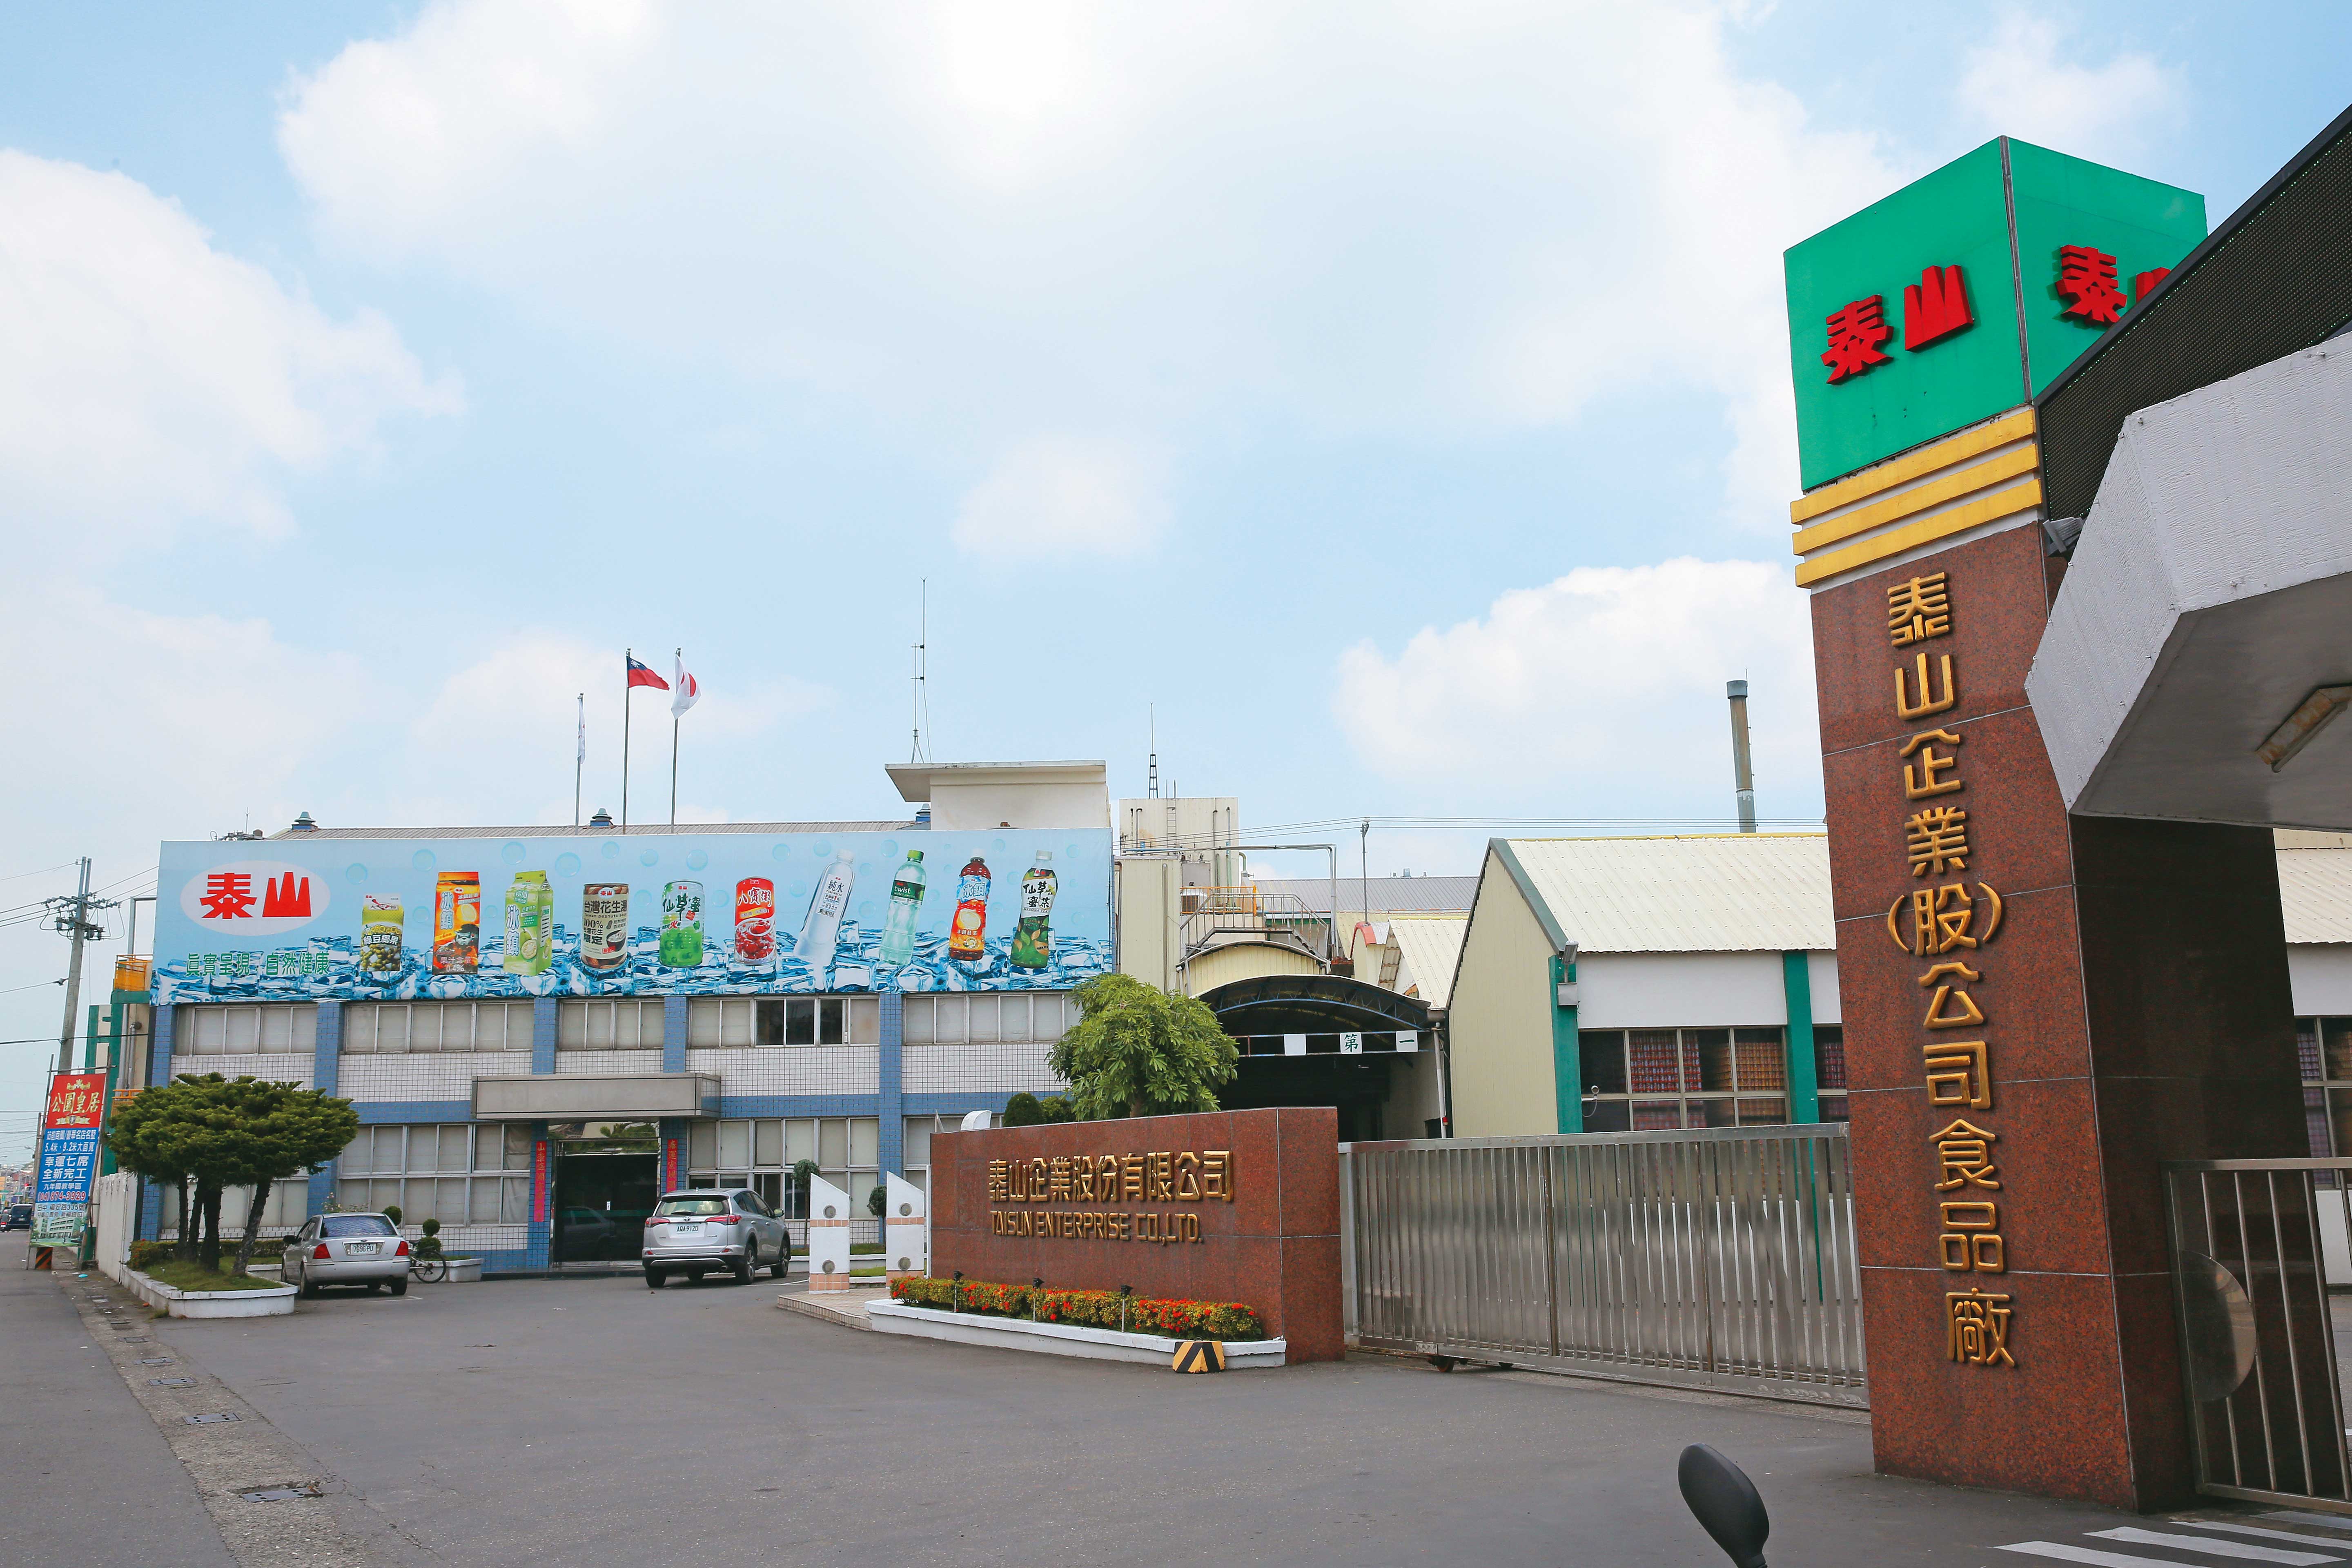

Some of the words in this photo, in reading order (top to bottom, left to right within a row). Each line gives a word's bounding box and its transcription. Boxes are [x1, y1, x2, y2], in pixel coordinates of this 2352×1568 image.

[1820, 264, 1974, 384] 泰山
[199, 872, 311, 919] 泰山
[827, 880, 844, 893] 純水
[894, 886, 911, 894] twist
[584, 900, 627, 914] 台灣花生湯
[662, 893, 701, 921] 仙草蜜
[738, 887, 771, 907] 八寶粥
[584, 919, 604, 929] 100%
[584, 927, 603, 935] 台灣花生
[363, 934, 399, 945] 綠豆椰果
[266, 951, 330, 976] 自然健康
[1886, 571, 2015, 1368] 泰山企業(股)公司食品廠
[51, 1091, 100, 1114] 公園皇居
[45, 1156, 89, 1167] 幸運七席
[42, 1168, 87, 1179] 全新完工
[989, 1150, 1234, 1202] 泰山企業股份有限公司
[989, 1210, 1034, 1236] TAISUN
[1036, 1211, 1131, 1241] ENTERPRISE
